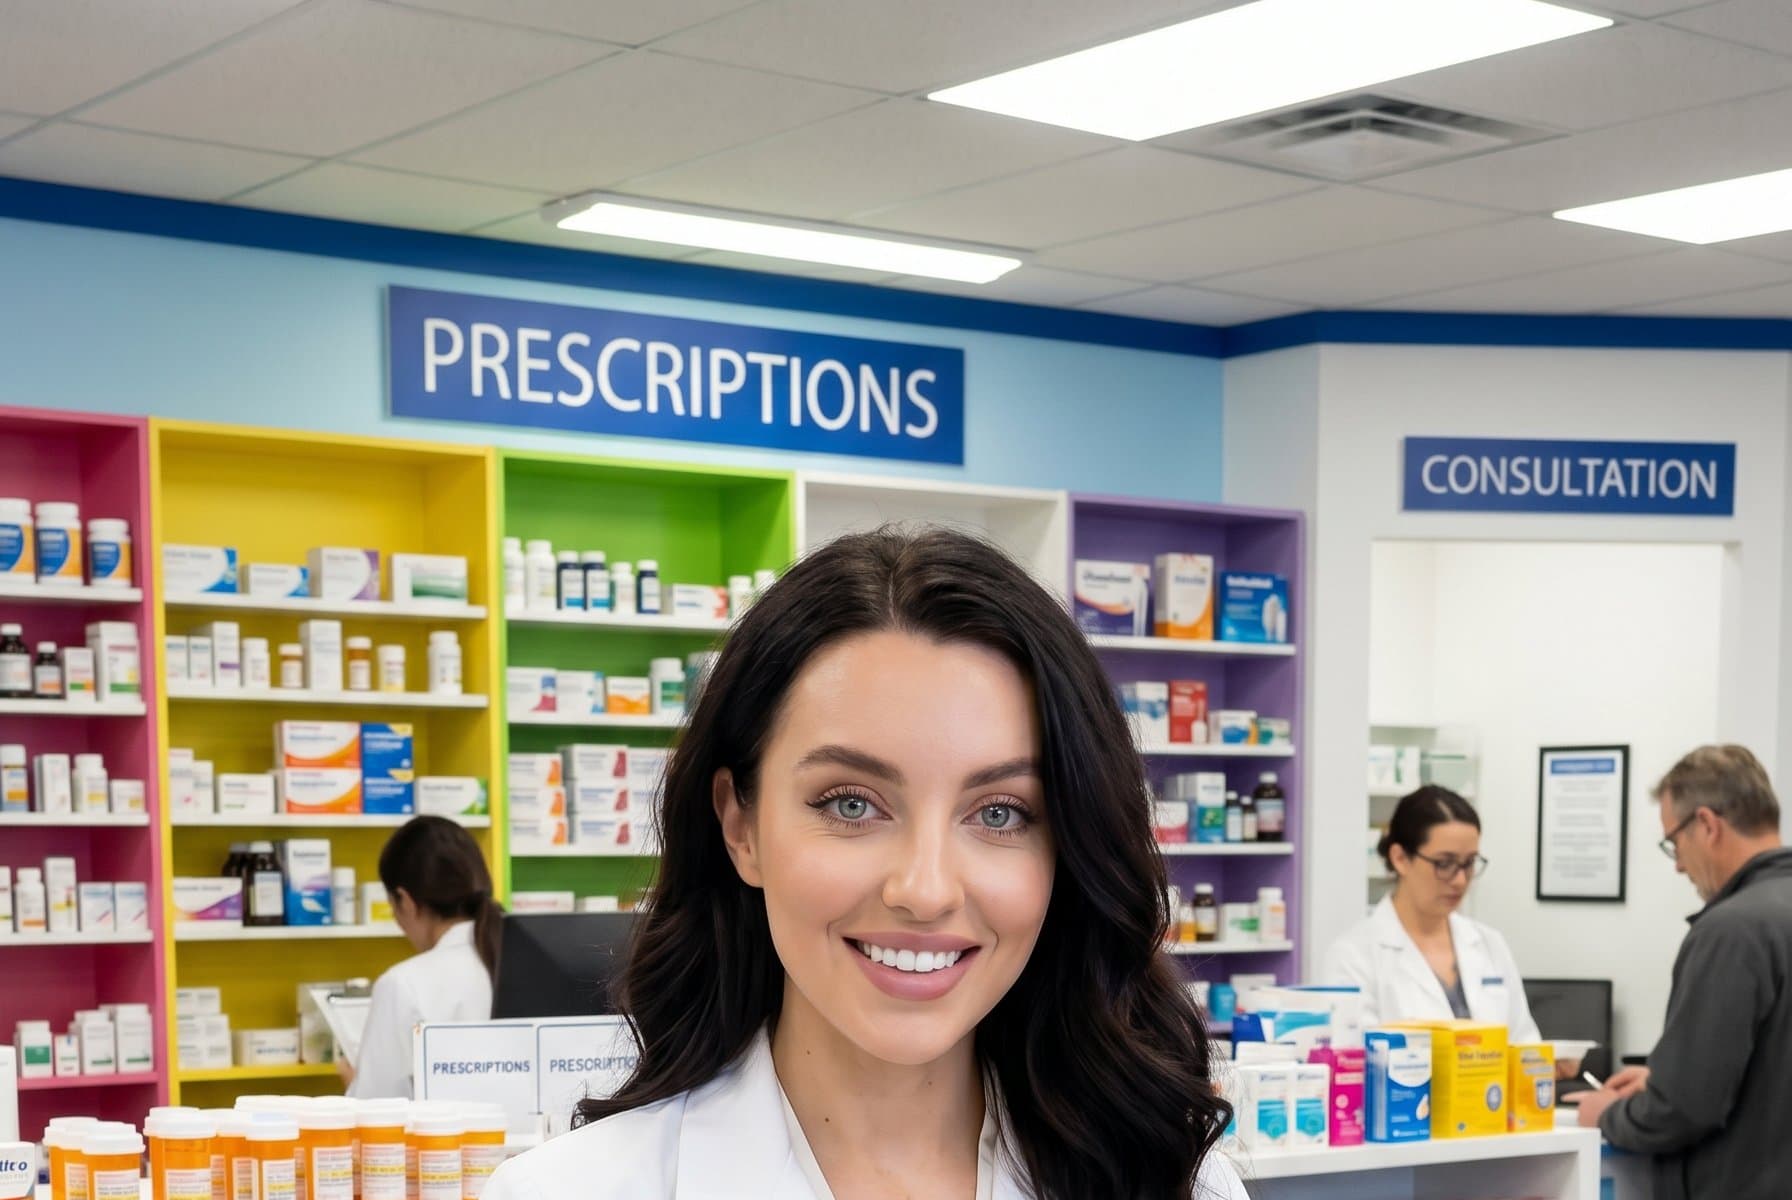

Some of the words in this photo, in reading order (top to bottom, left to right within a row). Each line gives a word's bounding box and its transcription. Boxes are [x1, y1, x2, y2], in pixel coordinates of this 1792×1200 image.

[422, 317, 940, 440] PRESCRIPTIONS
[1421, 455, 1717, 499] CONSULTATION
[432, 1060, 531, 1075] PRESCRIPTIONS
